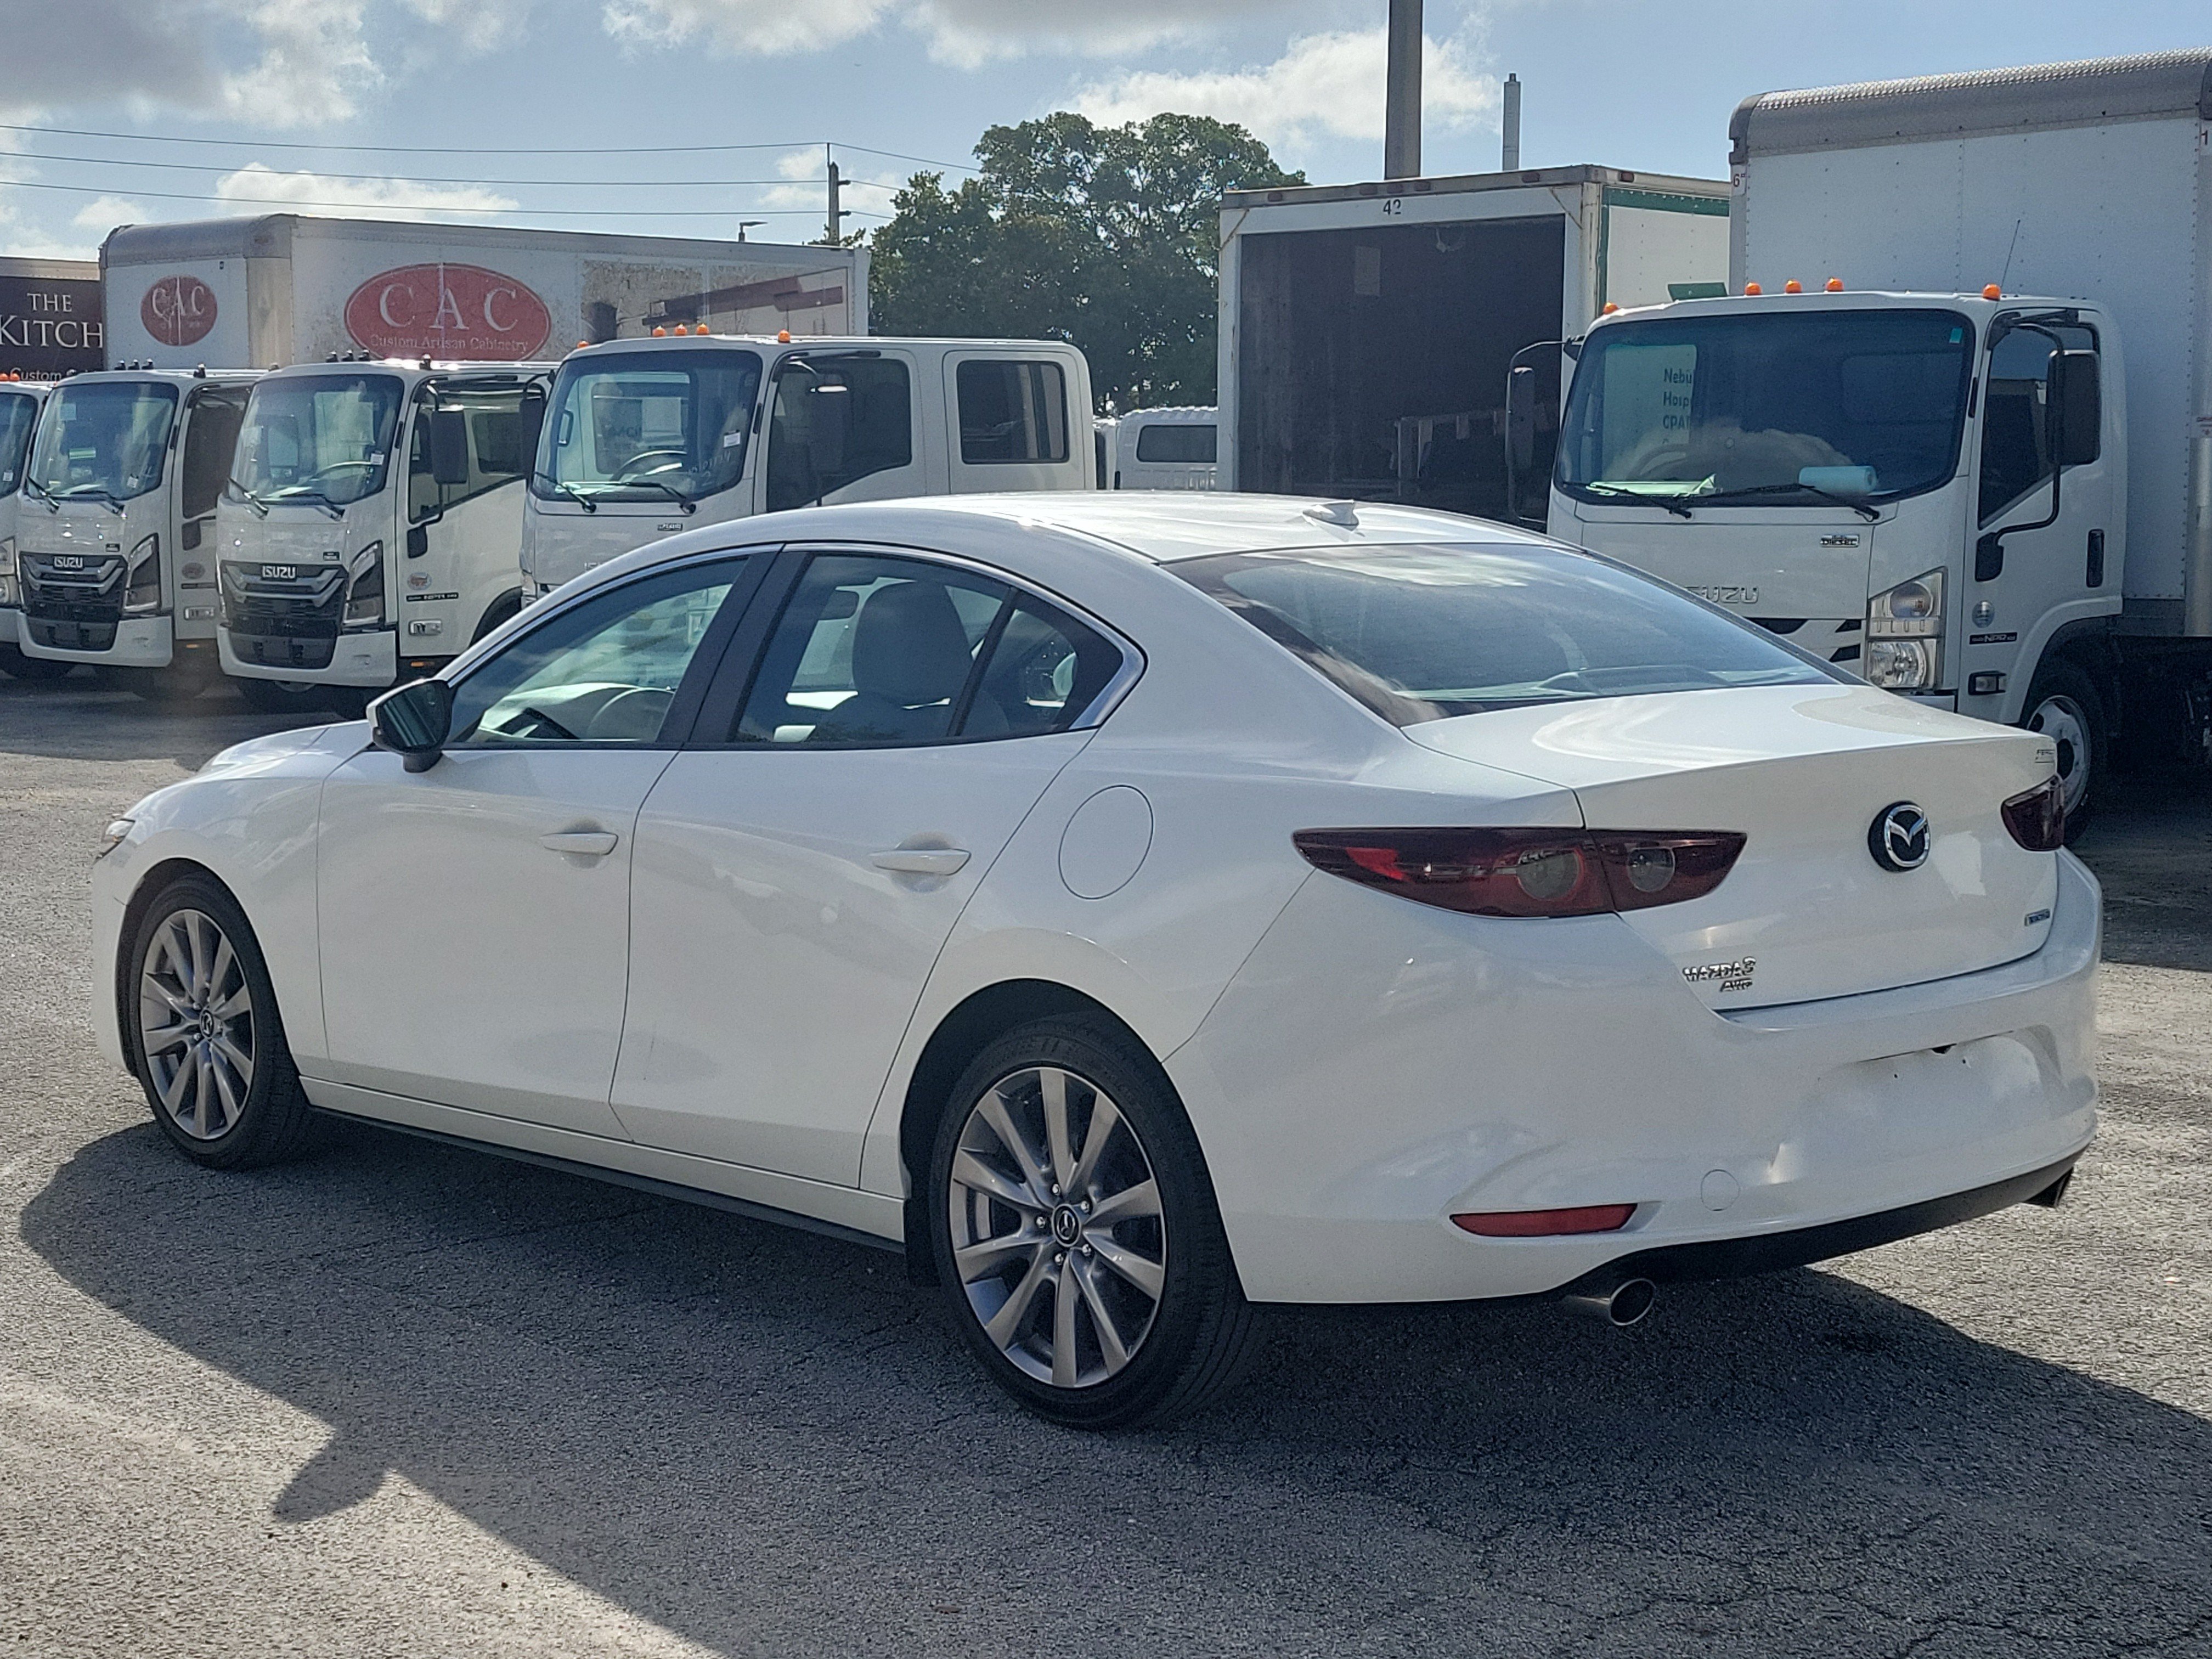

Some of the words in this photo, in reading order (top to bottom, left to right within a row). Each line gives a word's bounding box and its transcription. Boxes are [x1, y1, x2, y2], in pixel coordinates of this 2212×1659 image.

[1383, 199, 1401, 215] 42
[27, 293, 72, 312] THE
[0, 314, 103, 348] KITCH
[371, 334, 417, 349] Custom
[422, 336, 465, 350] Artisan
[470, 337, 528, 354] Cabinetry
[1664, 368, 1692, 383] Nebu
[54, 556, 83, 568] ISUZU
[262, 566, 296, 579] ISUZU
